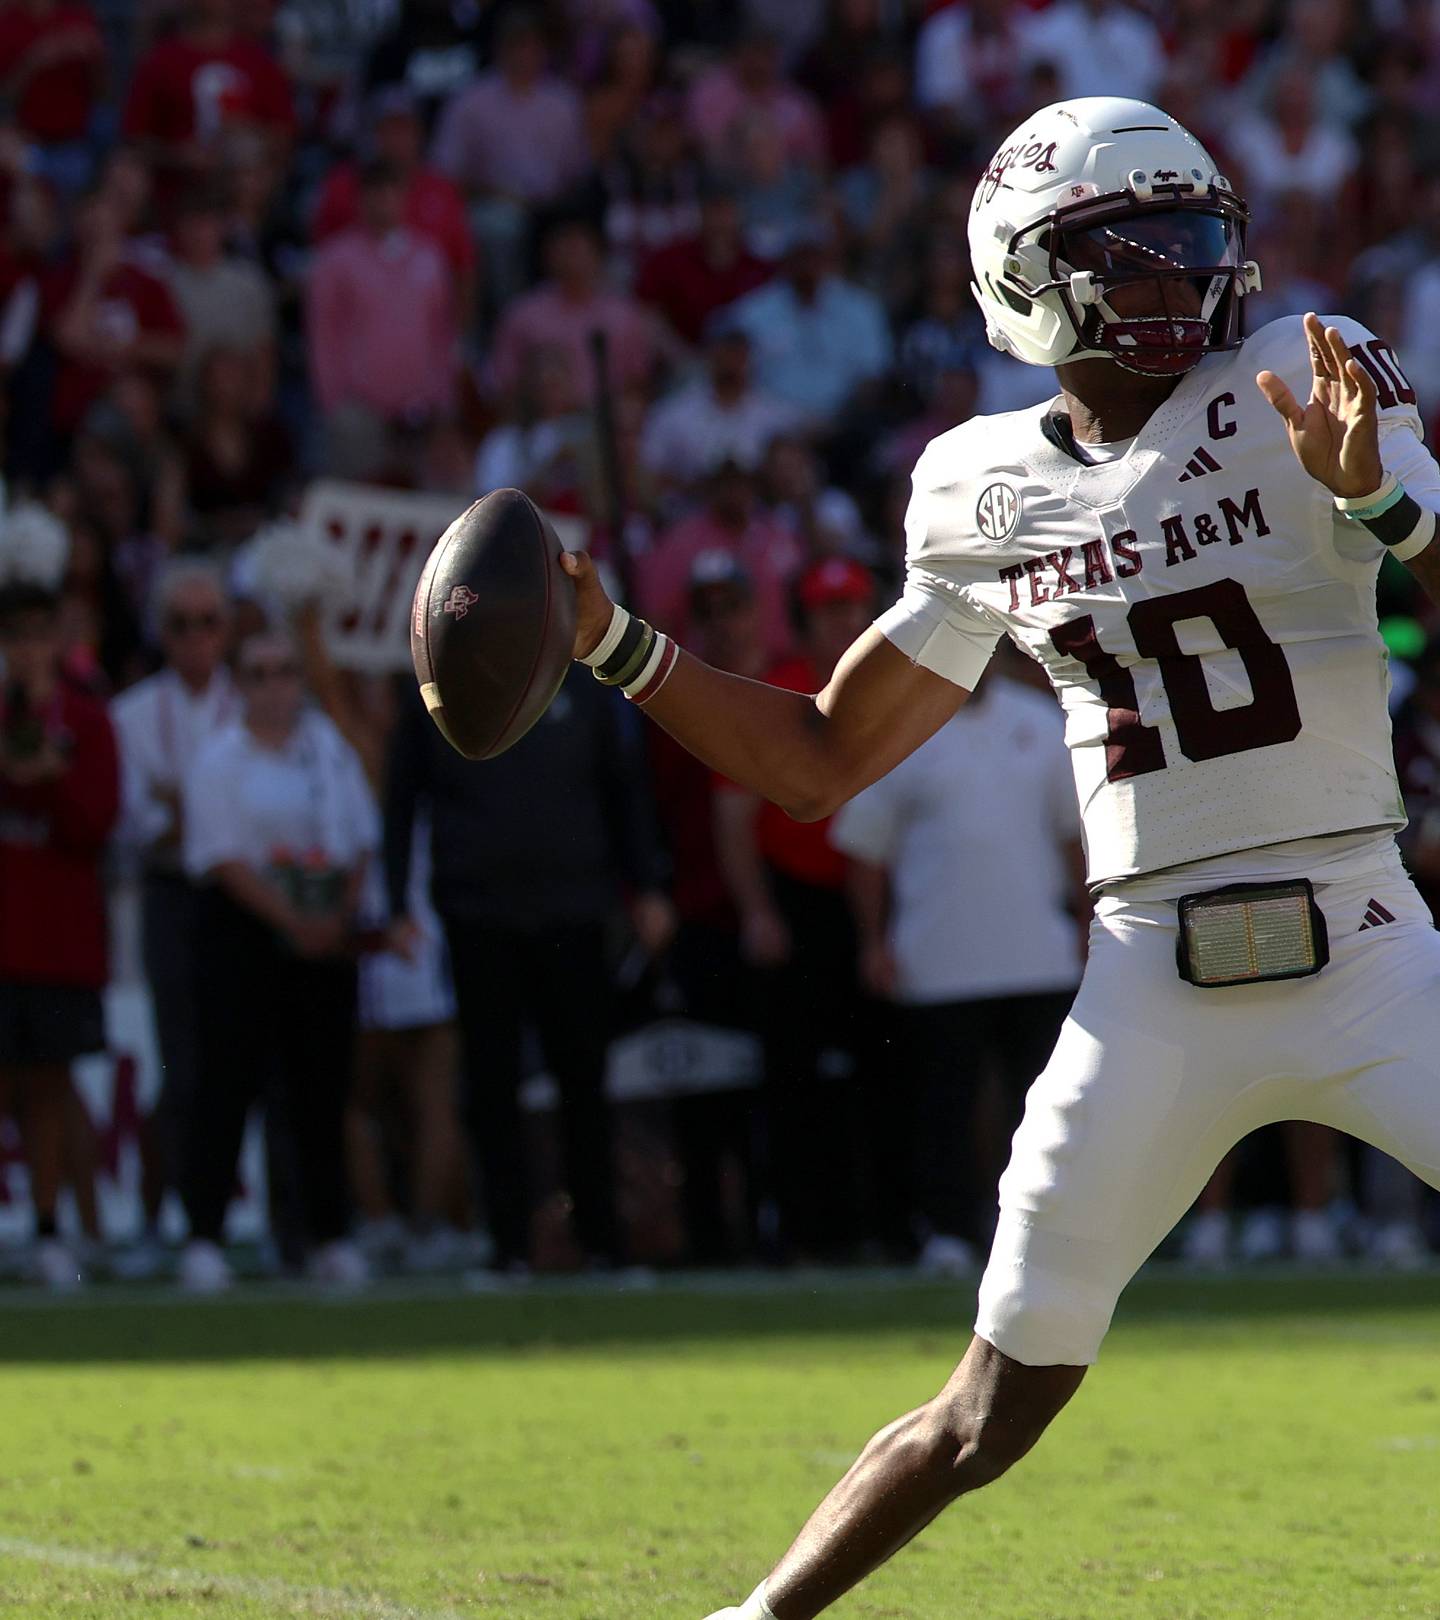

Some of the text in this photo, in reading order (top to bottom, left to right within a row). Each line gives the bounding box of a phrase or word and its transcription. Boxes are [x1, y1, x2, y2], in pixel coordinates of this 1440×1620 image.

[1207, 391, 1237, 440] C
[978, 485, 1018, 540] SEC
[998, 488, 1271, 613] TEXAS A&M
[1048, 577, 1302, 783] 10
